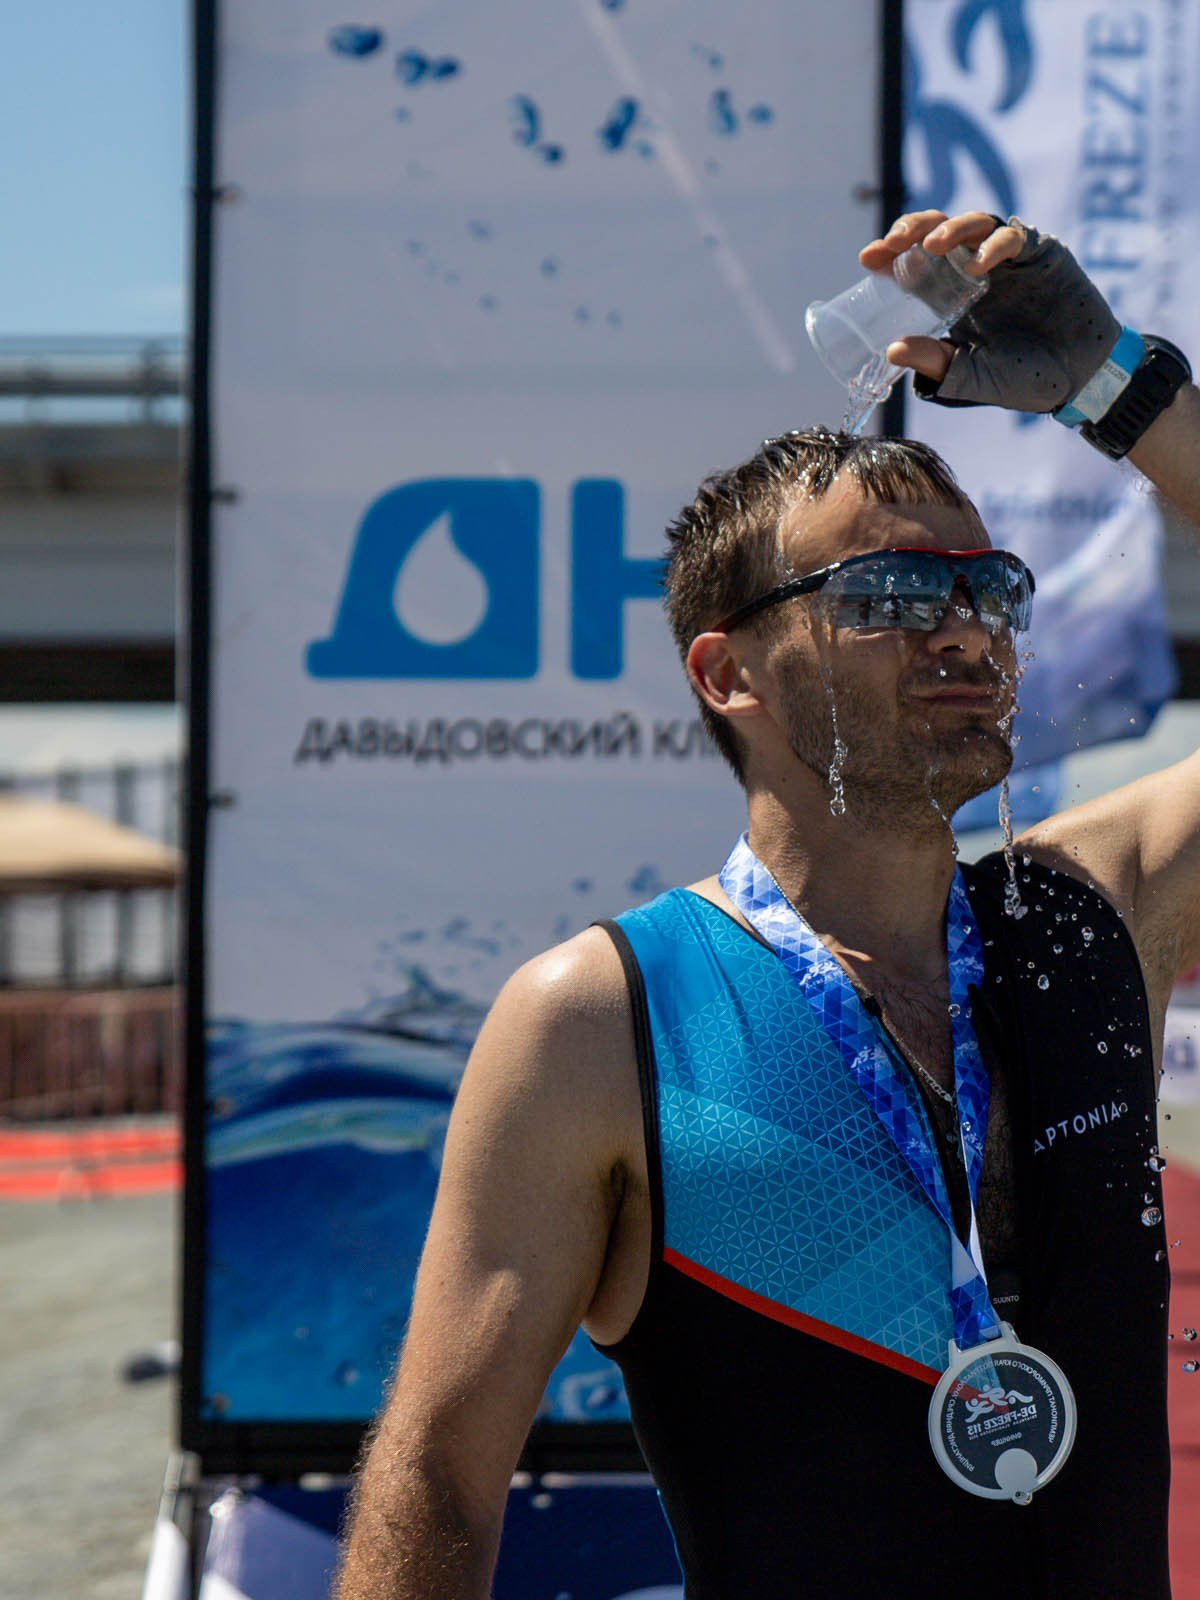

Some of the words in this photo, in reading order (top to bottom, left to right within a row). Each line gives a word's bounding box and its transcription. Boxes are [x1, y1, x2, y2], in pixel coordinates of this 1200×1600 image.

[1078, 13, 1150, 312] -FREZE
[295, 714, 642, 766] ДАВЫДОВСКИЙ
[653, 719, 717, 758] КЛ
[1034, 1101, 1121, 1155] APTONIA
[992, 1294, 1020, 1304] SUUNTO
